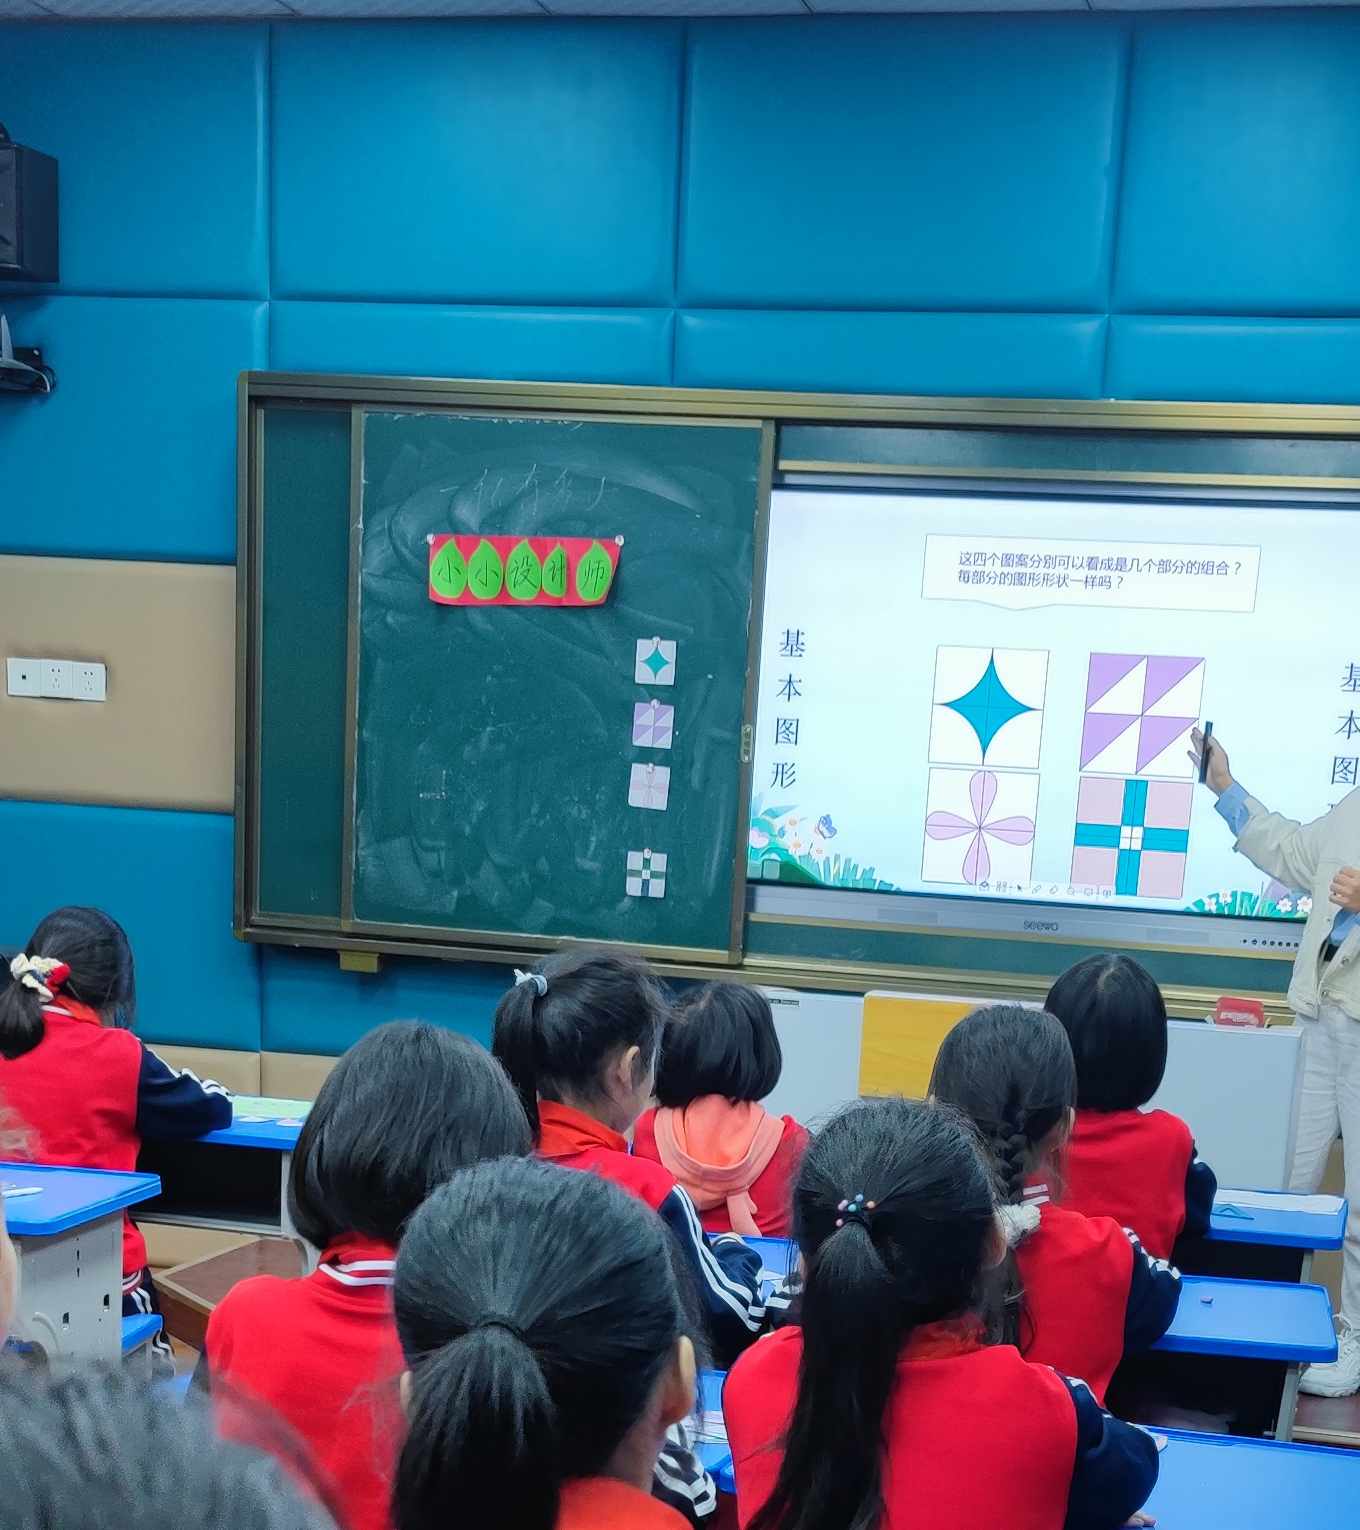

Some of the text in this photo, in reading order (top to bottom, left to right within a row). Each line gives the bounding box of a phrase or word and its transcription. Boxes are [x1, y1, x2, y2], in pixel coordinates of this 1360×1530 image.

[437, 553, 605, 594] 小小设计师
[957, 550, 1242, 576] 这四个图案分别可以看成是几个部分的组合？
[957, 568, 1124, 590] 每部分的图形形状一样吗？
[769, 628, 807, 790] 基本图形
